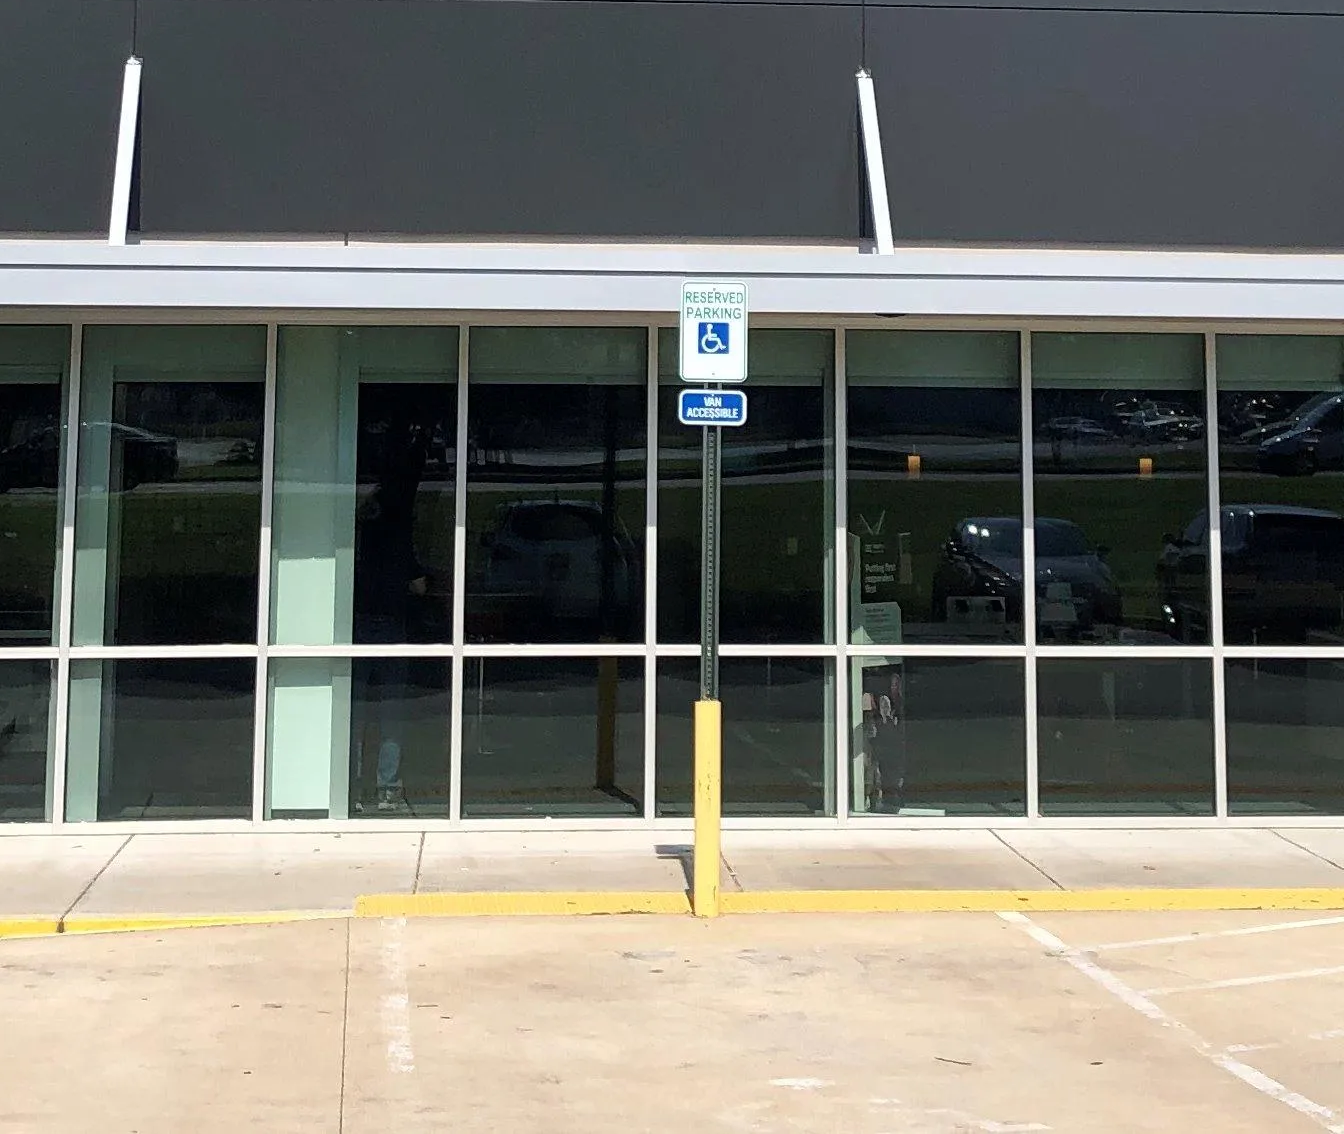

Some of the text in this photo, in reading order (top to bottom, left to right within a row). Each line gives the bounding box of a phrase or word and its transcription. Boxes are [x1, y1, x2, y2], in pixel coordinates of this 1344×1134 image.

[685, 291, 744, 304] RESERVED
[686, 307, 742, 320] PARKING
[703, 396, 723, 407] VAN
[686, 407, 739, 419] ACCESSIBLE
